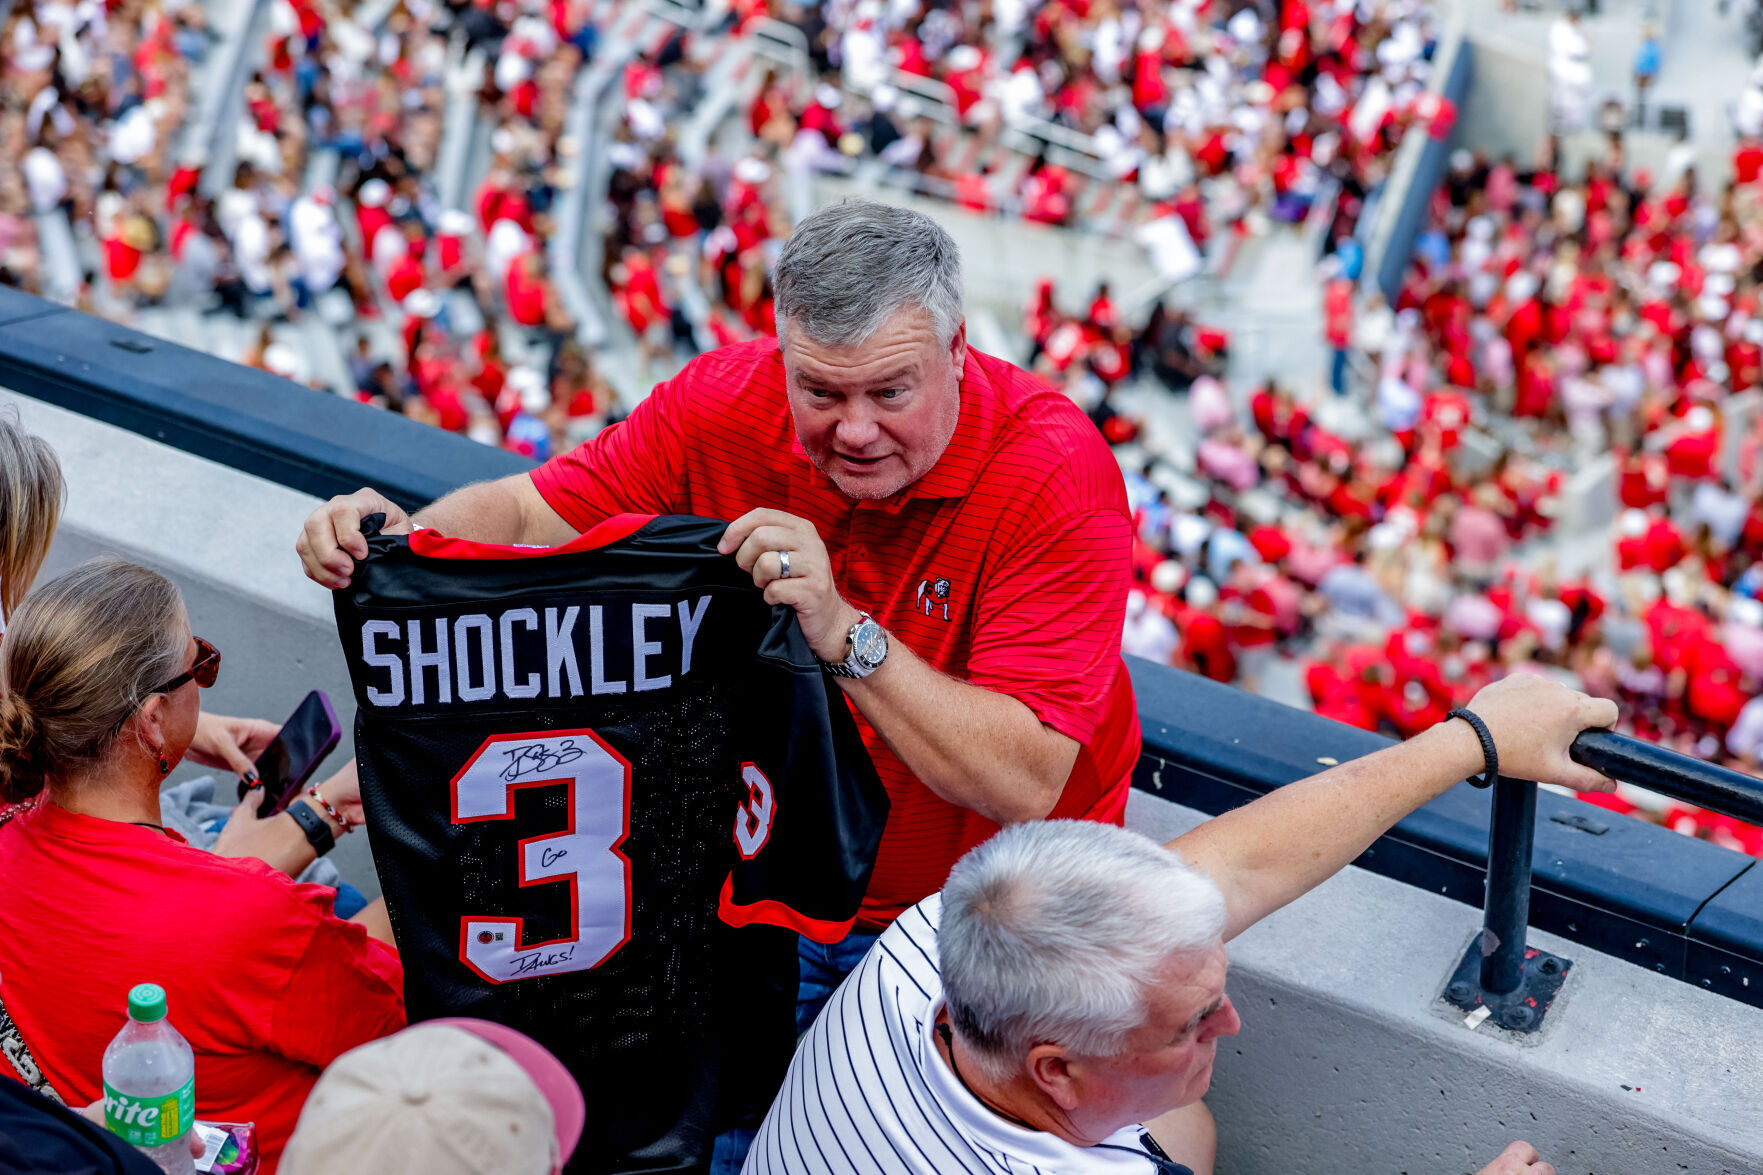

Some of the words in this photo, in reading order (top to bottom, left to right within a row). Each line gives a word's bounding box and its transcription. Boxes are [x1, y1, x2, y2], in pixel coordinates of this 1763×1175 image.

[361, 595, 712, 707] SHOCKLEY
[450, 728, 632, 985] 3
[541, 847, 568, 868] Go
[733, 761, 777, 860] 3
